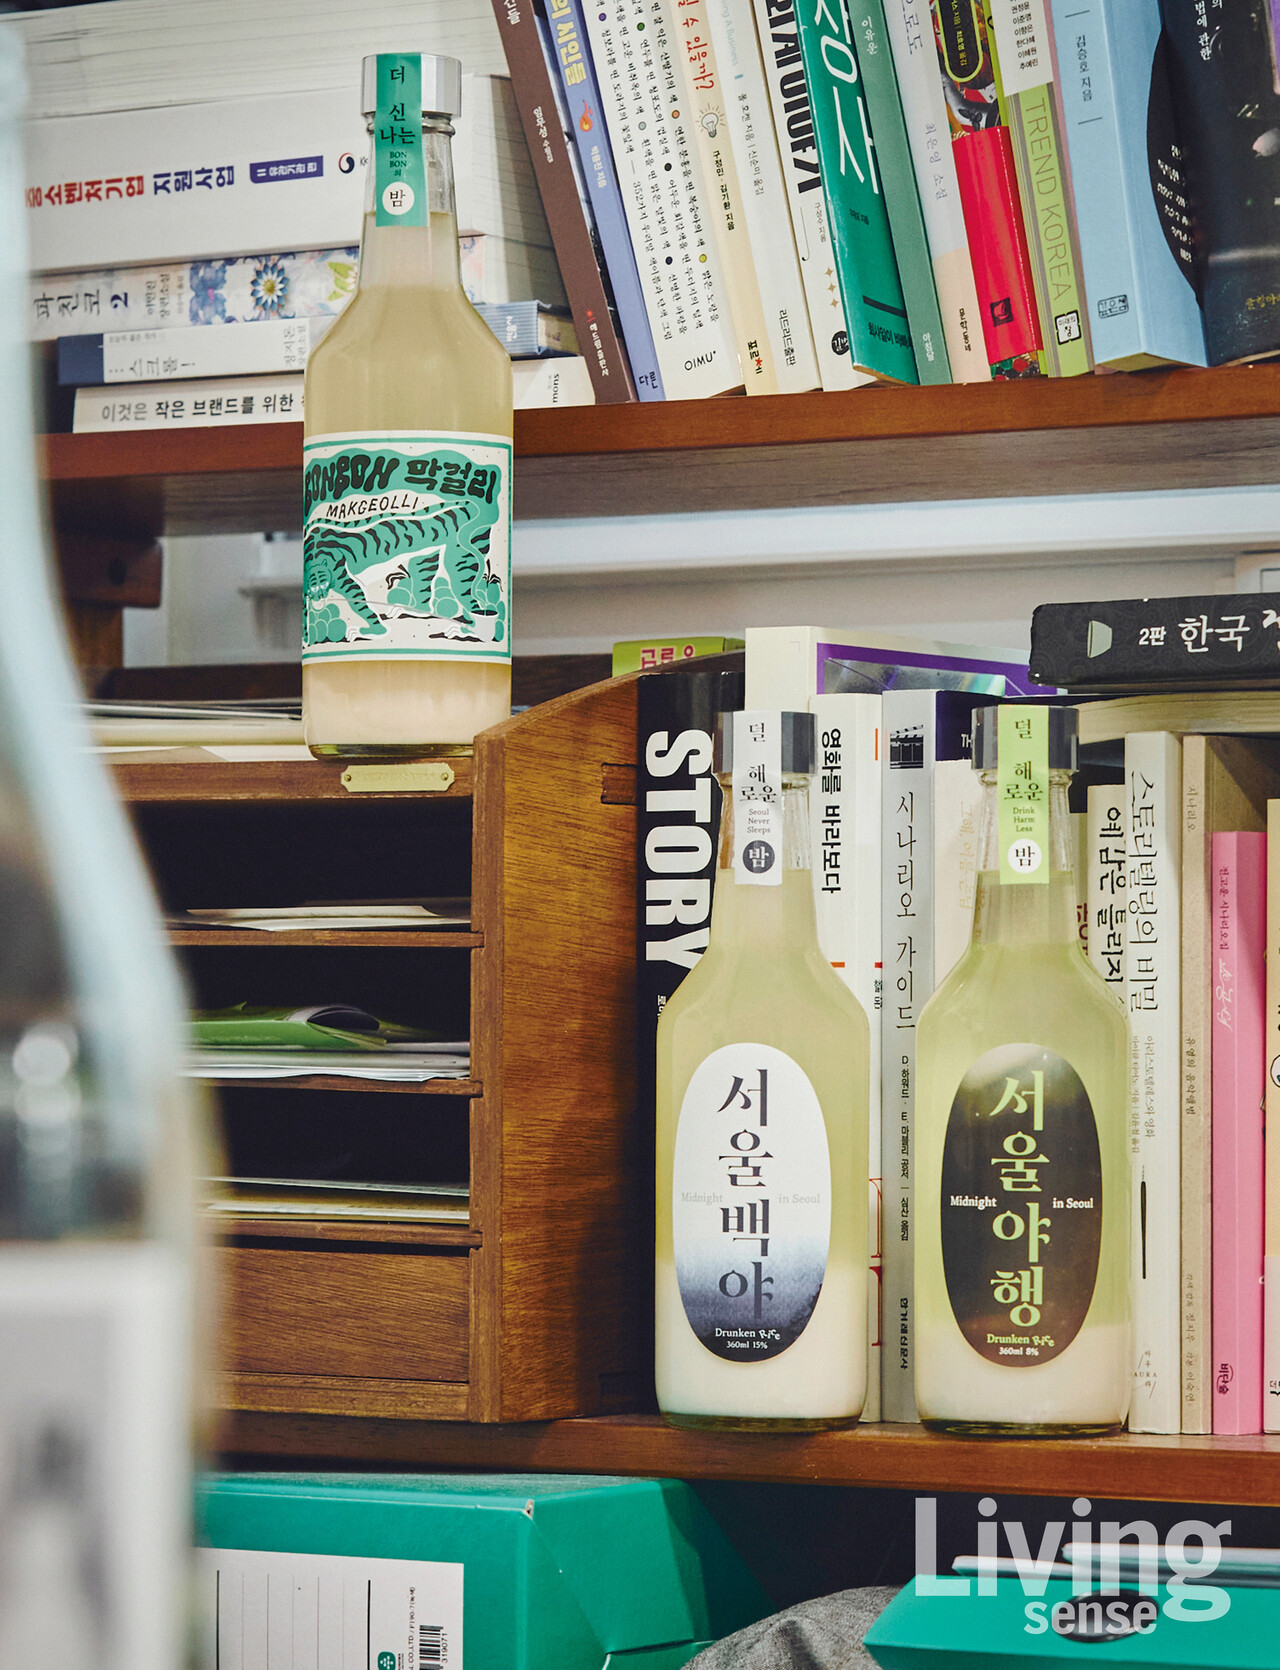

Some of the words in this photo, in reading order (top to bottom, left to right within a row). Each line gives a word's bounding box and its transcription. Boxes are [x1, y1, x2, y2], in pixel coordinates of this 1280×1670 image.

[681, 16, 699, 27] 수
[1012, 13, 1032, 24] 이준영
[1014, 24, 1034, 36] 이향은
[600, 29, 617, 65] 청보라를
[620, 39, 634, 59] 고운
[654, 27, 667, 47] 익은
[862, 16, 879, 55] 이유운
[1016, 35, 1035, 48] 한다혜
[1199, 32, 1211, 60] 관한
[551, 19, 588, 87] 시인들
[684, 34, 715, 91] 있을까?
[1017, 46, 1037, 58] 이혜원
[1077, 35, 1088, 73] 김승호
[391, 66, 405, 84] 더
[625, 62, 642, 101] 비취옥의
[658, 50, 676, 90] 산딸기의
[611, 82, 627, 120] 도라지의
[1082, 76, 1092, 102] 지음
[390, 103, 405, 121] 신
[633, 105, 645, 114] 색
[380, 126, 416, 144] 나는
[673, 125, 686, 146] 연한
[743, 124, 754, 140] 지음
[1026, 97, 1057, 196] TREND
[640, 138, 655, 166] 흰색을
[678, 149, 692, 177] 분홍을
[747, 150, 760, 176] 신순미
[923, 122, 941, 163] 최은영
[932, 172, 948, 200] 소설
[26, 175, 144, 208] 중소벤처기업
[153, 165, 235, 196] 지원사업
[390, 190, 405, 207] 밤
[631, 180, 648, 220] 352가지
[647, 85, 664, 123] 청포도의
[665, 179, 680, 208] 어두운
[682, 266, 699, 305] 두더지의
[753, 178, 763, 195] 옮김
[653, 205, 668, 236] 달빛의
[686, 194, 703, 233] 복숭아의
[723, 212, 735, 231] 지음
[639, 222, 654, 253] 우리말
[659, 239, 671, 249] 색
[695, 236, 706, 247] 색
[1041, 203, 1072, 300] KOREA
[646, 257, 662, 295] 색이름과
[666, 272, 681, 302] 선명한
[34, 290, 100, 319] 파친코
[110, 292, 128, 309] 2
[145, 281, 157, 315] 이민진
[653, 297, 667, 318] 단색
[706, 293, 721, 322] 노랑을
[658, 321, 671, 340] 그림
[672, 305, 688, 335] 파랑을
[284, 326, 296, 367] 정지돈
[777, 309, 795, 367] 리드리드출판
[102, 404, 148, 422] 이것은
[155, 400, 185, 419] 작은
[192, 396, 255, 416] 브랜드를
[262, 394, 293, 413] 위한
[404, 459, 497, 503] 막걸리
[326, 494, 419, 519] MAKGEOLLI
[1139, 626, 1166, 646] 2판
[1178, 614, 1250, 653] 한국
[749, 723, 765, 742] 덜
[1015, 719, 1032, 739] 덜
[822, 728, 841, 795] 영화를
[740, 786, 777, 803] 로운
[1004, 783, 1044, 801] 로운
[748, 817, 770, 825] Never
[1186, 785, 1198, 831] 시나리오
[747, 826, 771, 834] Sleeps
[646, 729, 713, 970] STORY
[749, 847, 770, 868] 밤
[822, 805, 841, 894] 바라보다
[896, 792, 916, 917] 시나리오
[1015, 846, 1036, 866] 밤
[1099, 806, 1126, 895] 예감은
[1129, 771, 1158, 943] 스토리텔링의
[1219, 866, 1229, 897] 전고운
[1219, 900, 1229, 950] 시나리오집
[1098, 903, 1126, 982] 틀리지
[896, 936, 916, 1029] 가이드
[1129, 957, 1158, 1012] 비밀
[1186, 1037, 1196, 1068] 유열의
[1144, 1035, 1155, 1115] 아리스토텔레스와
[1132, 1089, 1140, 1104] 지음
[1186, 1073, 1197, 1115] 음악앨범
[1144, 1118, 1155, 1138] 영화
[901, 1159, 909, 1179] 공저
[681, 1192, 723, 1206] Midnight
[779, 1194, 788, 1203] in
[792, 1194, 820, 1204] Seoul
[717, 1069, 774, 1320] 서울백야
[901, 1197, 909, 1217] 심산
[950, 1196, 997, 1210] Midnight
[1053, 1197, 1063, 1208] in
[1066, 1197, 1094, 1209] Seoul
[989, 1070, 1052, 1327] 서울야행
[901, 1220, 909, 1241] 옮김
[715, 1328, 755, 1338] Drunken
[987, 1334, 1029, 1344] Drunken
[1185, 1313, 1195, 1343] 정지우
[726, 1341, 749, 1349] 360ml
[752, 1341, 768, 1349] 15%
[999, 1347, 1023, 1355] 360ml
[1026, 1347, 1039, 1355] 8%
[1185, 1371, 1195, 1402] 이숙연
[441, 1632, 449, 1664] 319071
